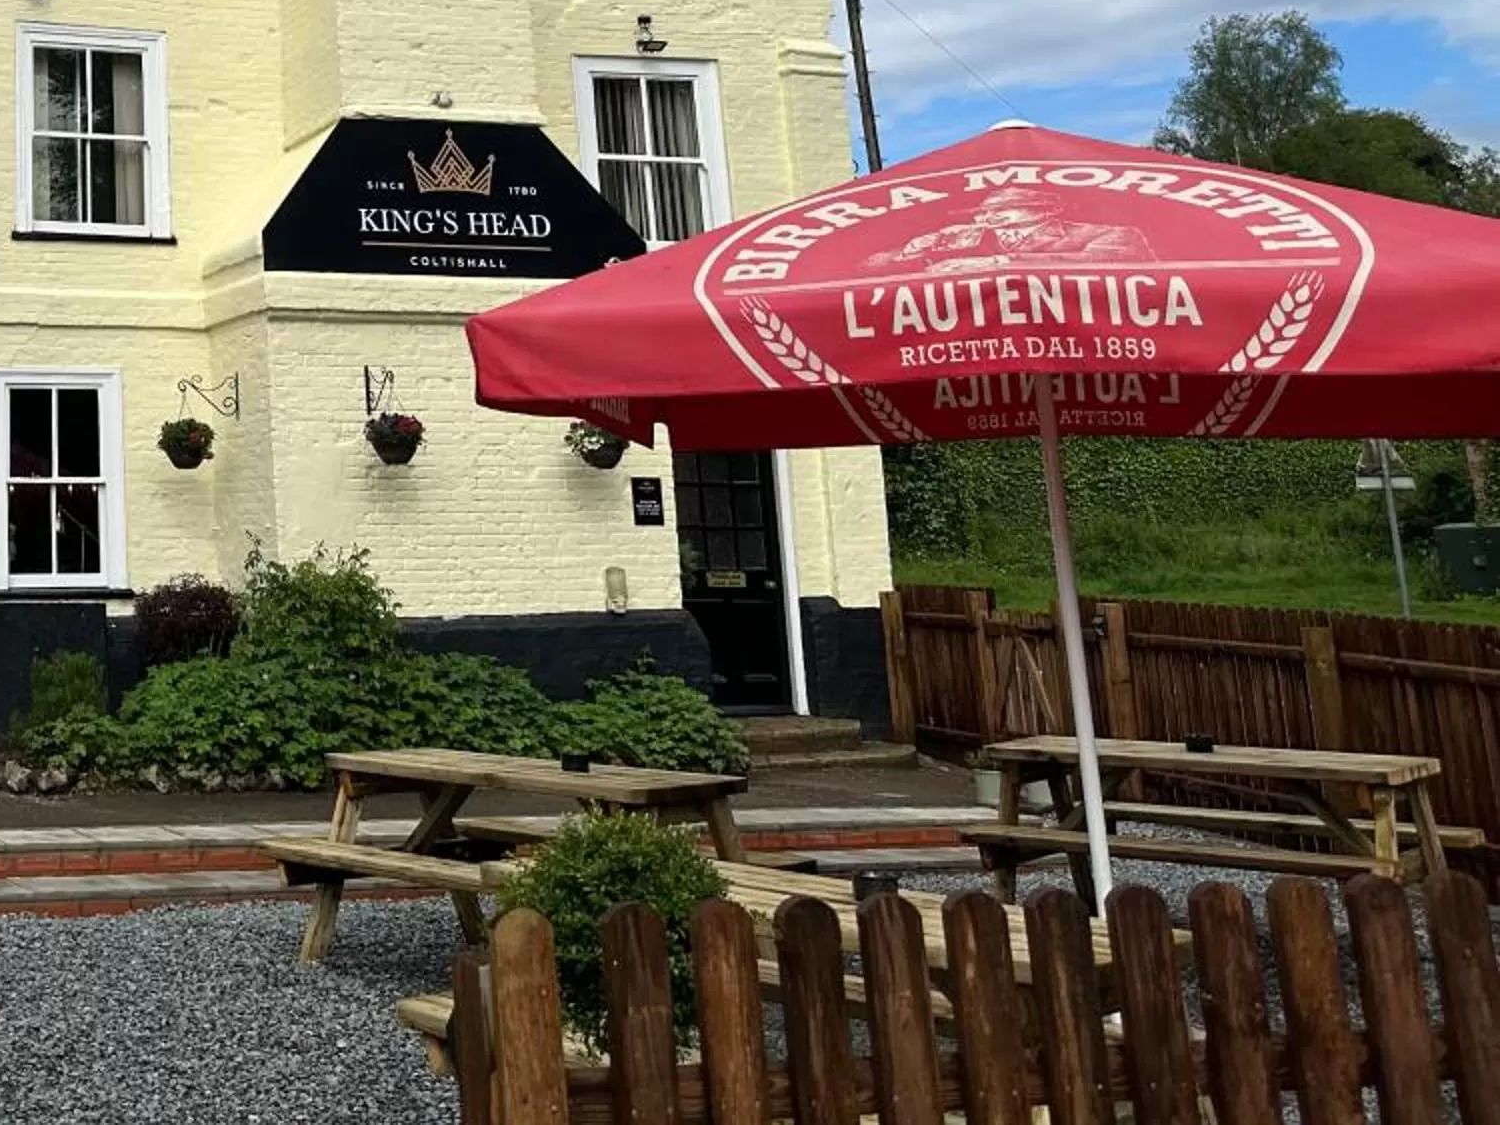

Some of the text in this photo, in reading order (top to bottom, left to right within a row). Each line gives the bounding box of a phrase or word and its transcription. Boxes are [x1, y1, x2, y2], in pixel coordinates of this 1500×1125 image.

[358, 208, 551, 238] KING'S HEAD
[724, 164, 1340, 285] BIRRA MORETTI
[409, 256, 507, 268] COLTISHALL
[843, 273, 1203, 338] L'AUTENTICA
[900, 335, 1156, 367] RICETTA DAL 1859
